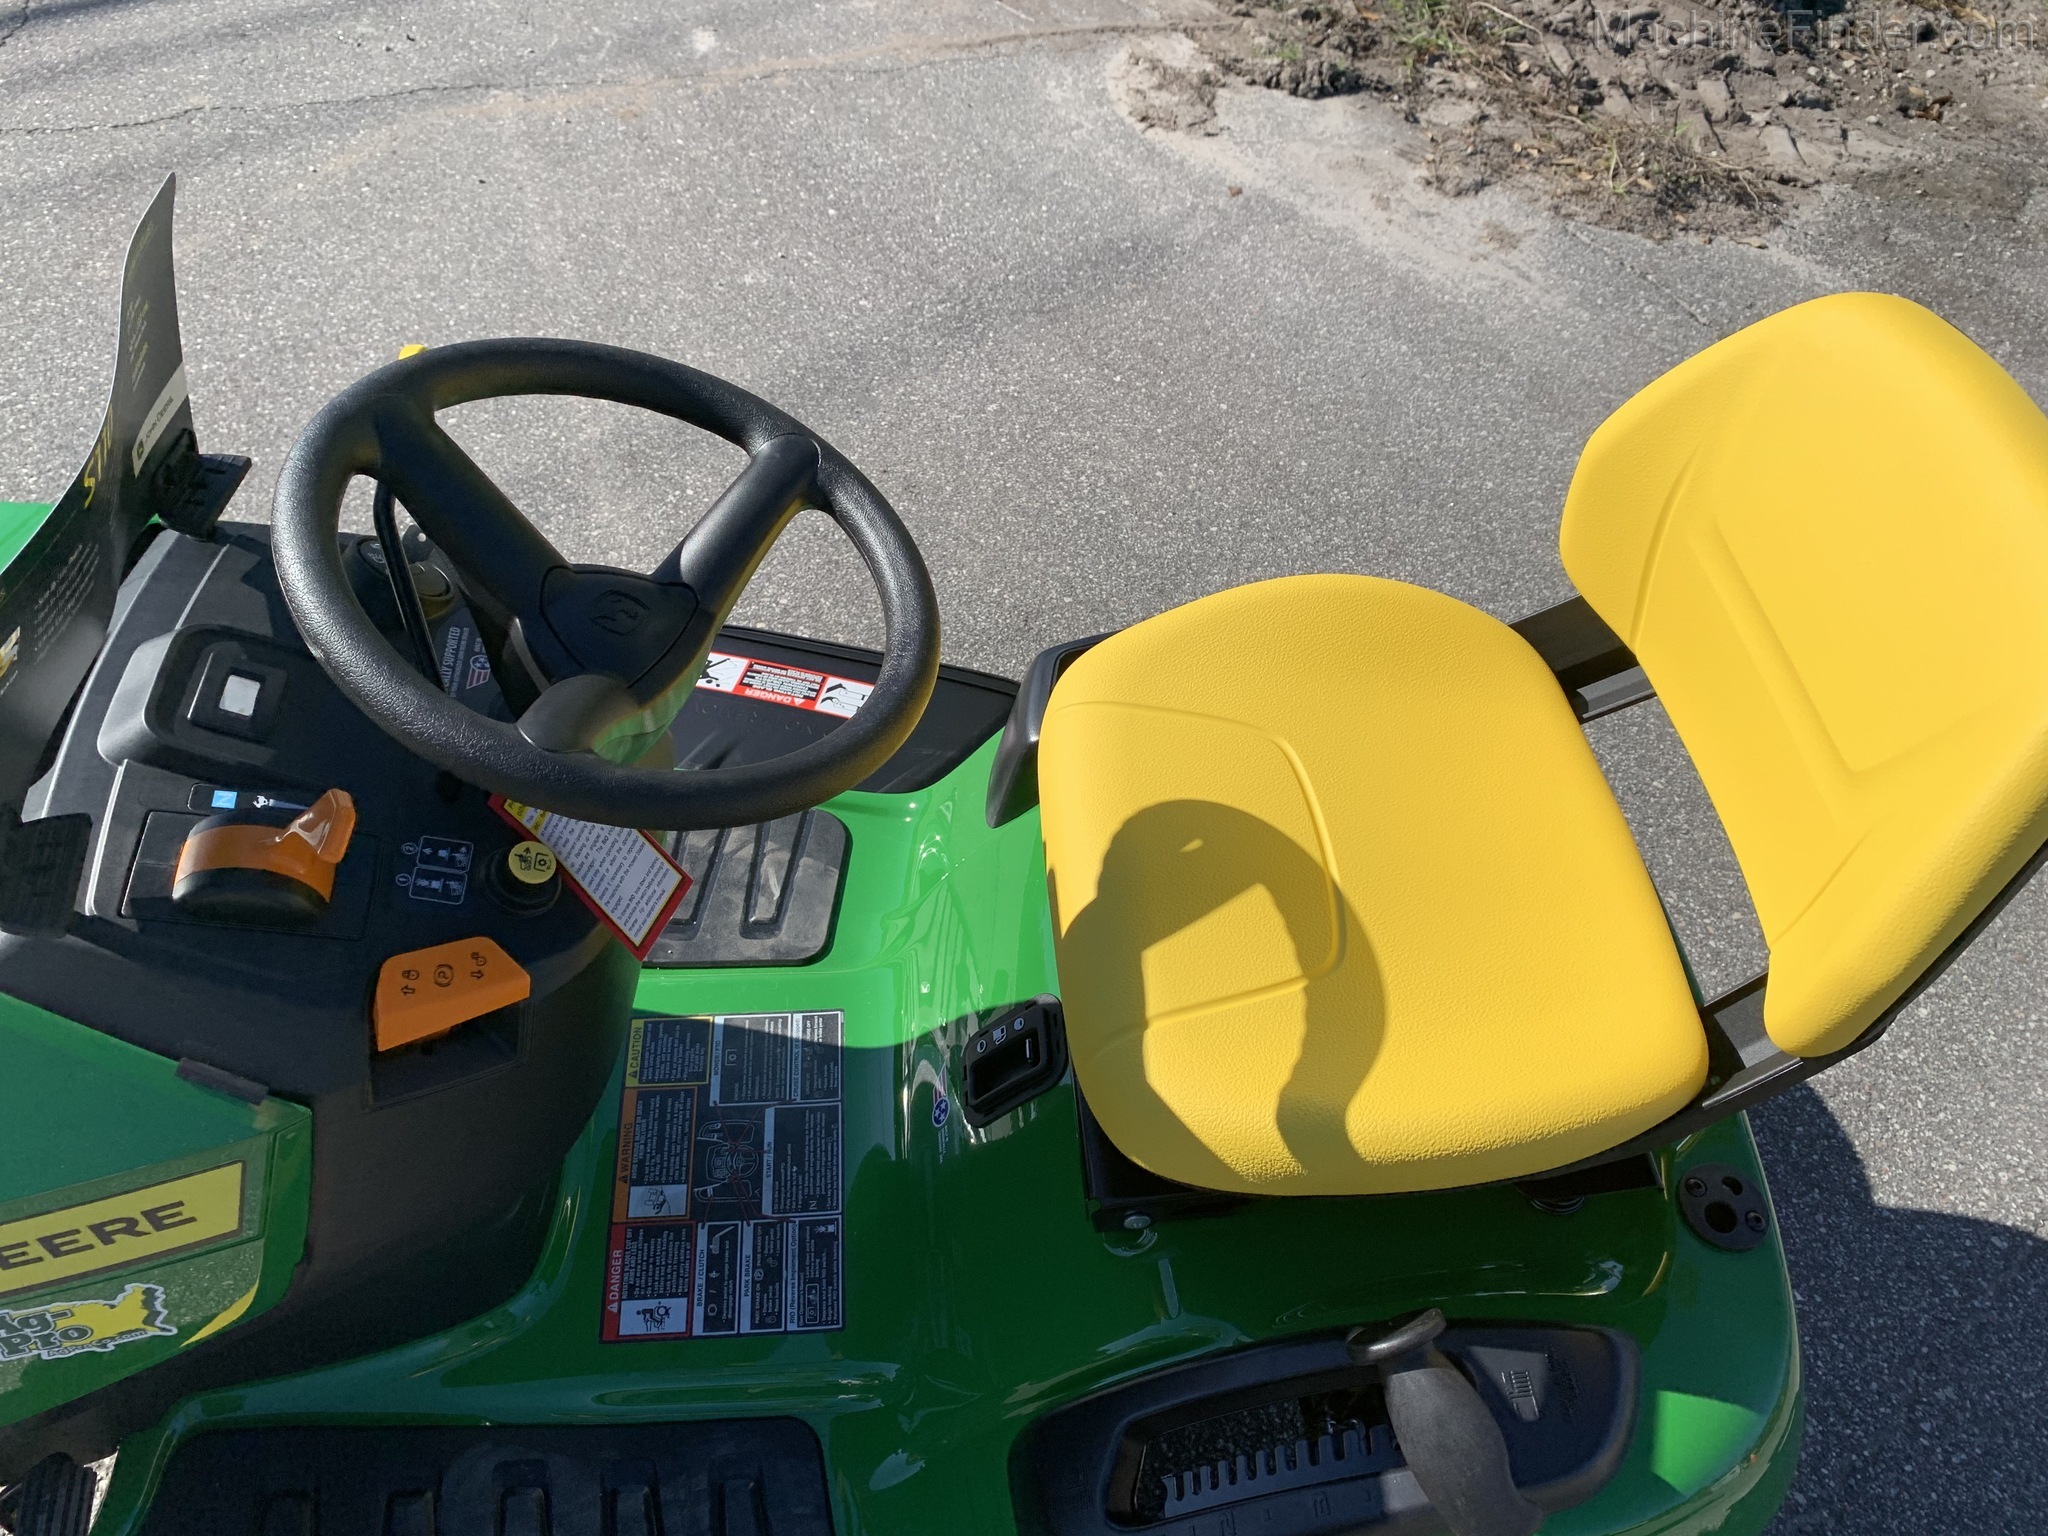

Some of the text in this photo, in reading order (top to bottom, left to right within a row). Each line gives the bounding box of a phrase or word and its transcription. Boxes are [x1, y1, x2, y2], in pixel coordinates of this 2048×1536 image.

[442, 625, 460, 666] SUPPORTED
[744, 687, 791, 703] DANGER
[630, 1027, 642, 1068] CAUTION
[620, 1122, 632, 1172] WARNING
[609, 1249, 622, 1300] DANGER
[0, 1325, 93, 1358] Pro
